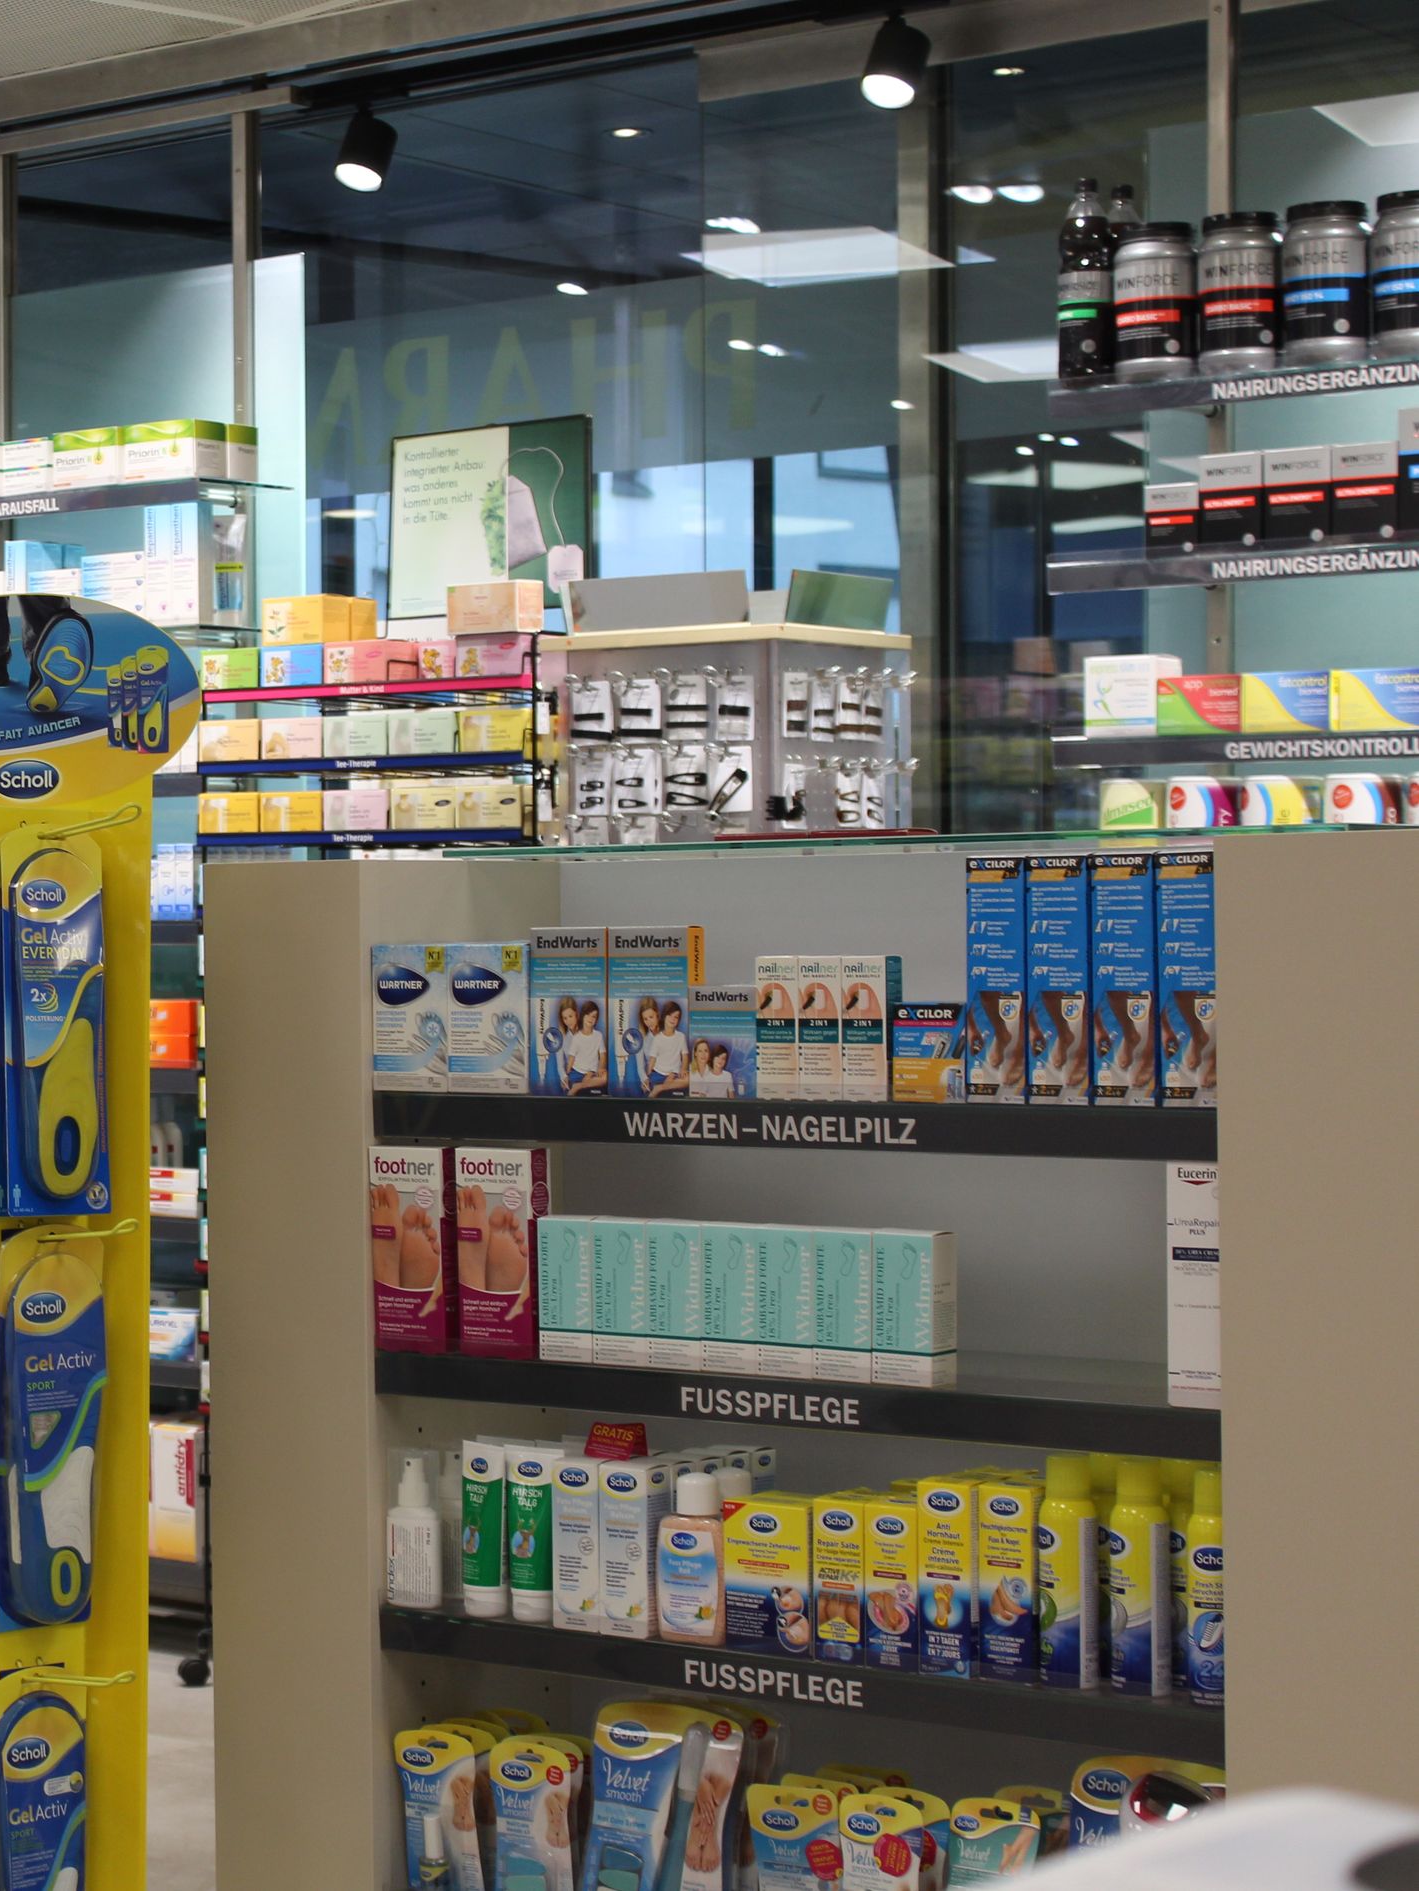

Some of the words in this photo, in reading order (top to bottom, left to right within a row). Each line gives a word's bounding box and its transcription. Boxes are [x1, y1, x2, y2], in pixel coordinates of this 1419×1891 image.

[1203, 263, 1274, 279] WINFORCE
[1116, 273, 1182, 290] WINFORCE
[127, 448, 160, 459] Priorin
[404, 447, 460, 462] Kontrollierter
[55, 456, 85, 466] Priorin
[403, 497, 431, 509] kommt
[434, 497, 448, 506] uns
[452, 491, 473, 504] nicht
[335, 759, 377, 768] Tee-Therapie
[0, 770, 55, 789] Scholl
[332, 833, 374, 843] Tee-Therapie
[26, 887, 63, 902] Scholl
[20, 927, 48, 945] Gel
[536, 935, 599, 949] EndWarts
[614, 934, 682, 949] EndWarts
[22, 946, 87, 959] EVERYDAY
[379, 980, 424, 990] WARTNER
[454, 980, 501, 990] WARTNER
[30, 988, 48, 1002] 2x
[695, 991, 749, 1003] EndWarts
[374, 1156, 435, 1176] footner
[460, 1157, 523, 1177] footner
[1177, 1167, 1217, 1180] Eucerin
[1189, 1228, 1206, 1236] PLUS
[576, 1235, 590, 1328] Widmer
[630, 1238, 645, 1330] Widmer
[685, 1239, 700, 1335] Widmer
[741, 1242, 755, 1337] Widmer
[795, 1245, 810, 1342] Widmer
[854, 1249, 870, 1346] Widmer
[915, 1251, 931, 1350] Widmer
[25, 1301, 63, 1316] Scholl
[24, 1355, 55, 1373] Gel
[56, 1352, 95, 1369] Activ
[26, 1379, 56, 1392] SPORT
[680, 1385, 861, 1426] FUSSPFLEGE
[593, 1425, 634, 1441] GRATIS
[562, 1472, 589, 1484] Scholl
[609, 1477, 637, 1490] Scholl
[466, 1483, 488, 1496] HIRSCH
[512, 1486, 543, 1498] HIRSCH
[469, 1493, 485, 1504] TALG
[517, 1496, 538, 1507] TALG
[930, 1495, 958, 1508] Scholl
[992, 1500, 1017, 1512] Scholl
[751, 1518, 776, 1530] Scholl
[825, 1515, 852, 1527] Scholl
[936, 1522, 951, 1531] Anti
[927, 1530, 960, 1540] Hornhaut
[817, 1538, 839, 1548] Repair
[840, 1540, 860, 1550] Salbe
[932, 1546, 956, 1556] Crème
[928, 1555, 960, 1565] intensive
[940, 1636, 960, 1647] TAGEN
[941, 1650, 961, 1660] JOURS
[684, 1658, 864, 1707] FUSSPFLEGE
[11, 1744, 47, 1763] Scholl
[602, 1756, 650, 1791] Velvet
[404, 1771, 441, 1794] Velvet
[605, 1788, 642, 1801] smooth
[9, 1806, 36, 1825] Gel
[35, 1800, 68, 1821] Activ
[10, 1829, 35, 1840] SPORT
[958, 1838, 991, 1861] Velvet
